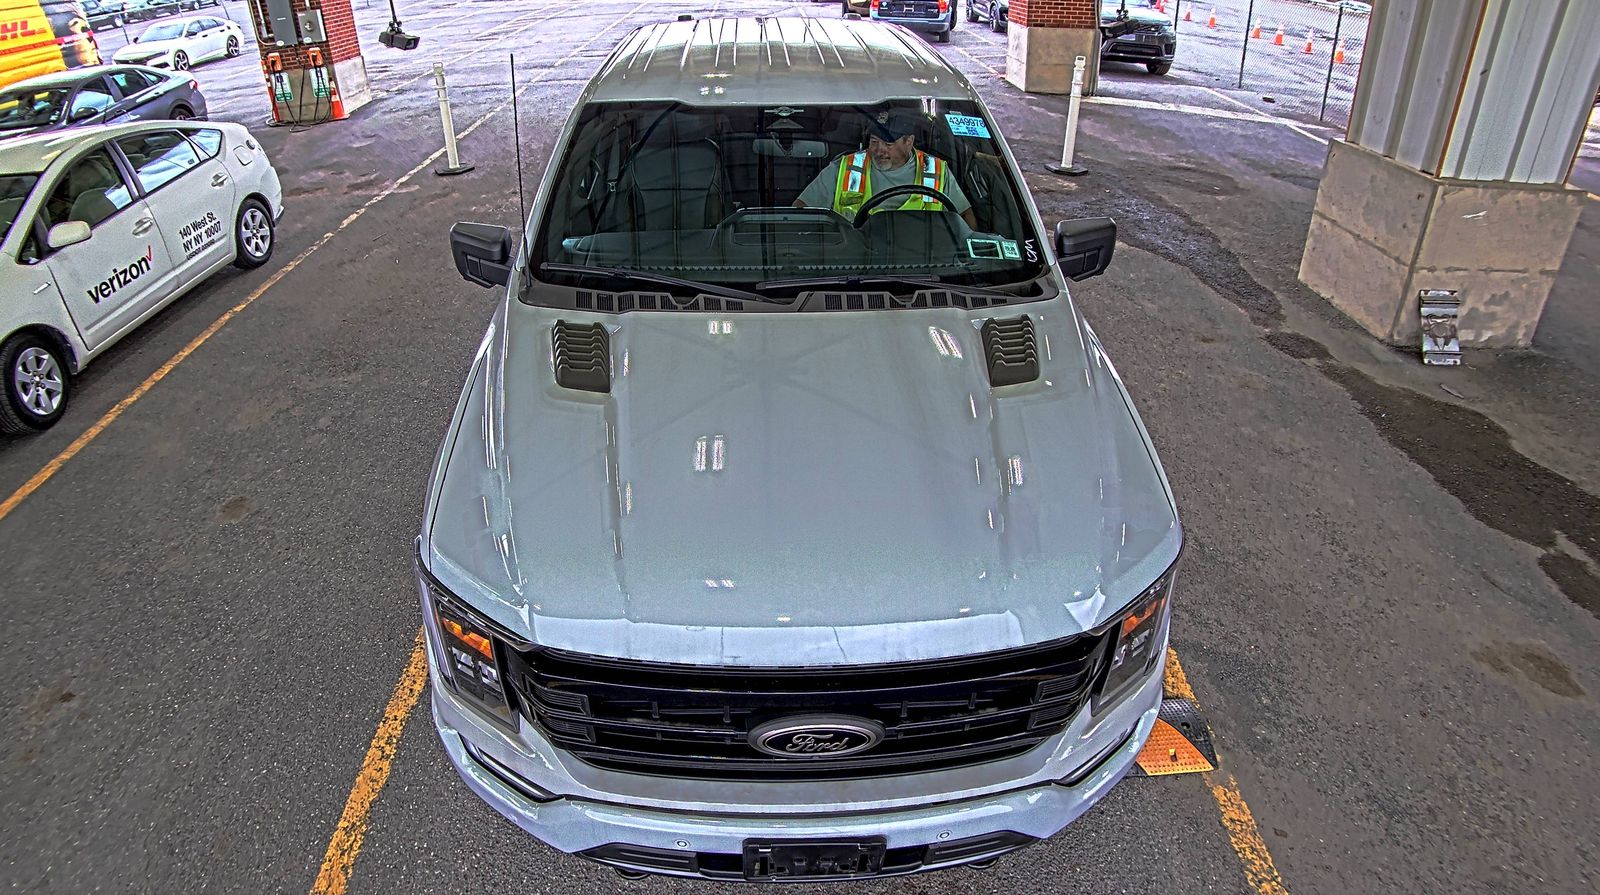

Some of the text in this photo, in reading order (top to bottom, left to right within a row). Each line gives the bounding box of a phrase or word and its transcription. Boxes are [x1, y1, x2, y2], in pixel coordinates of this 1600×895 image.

[179, 211, 217, 240] 140 West St.
[183, 239, 193, 253] NY
[193, 232, 203, 246] NY
[204, 221, 221, 238] 10007
[86, 256, 150, 304] verizon
[785, 733, 849, 752] Ford
